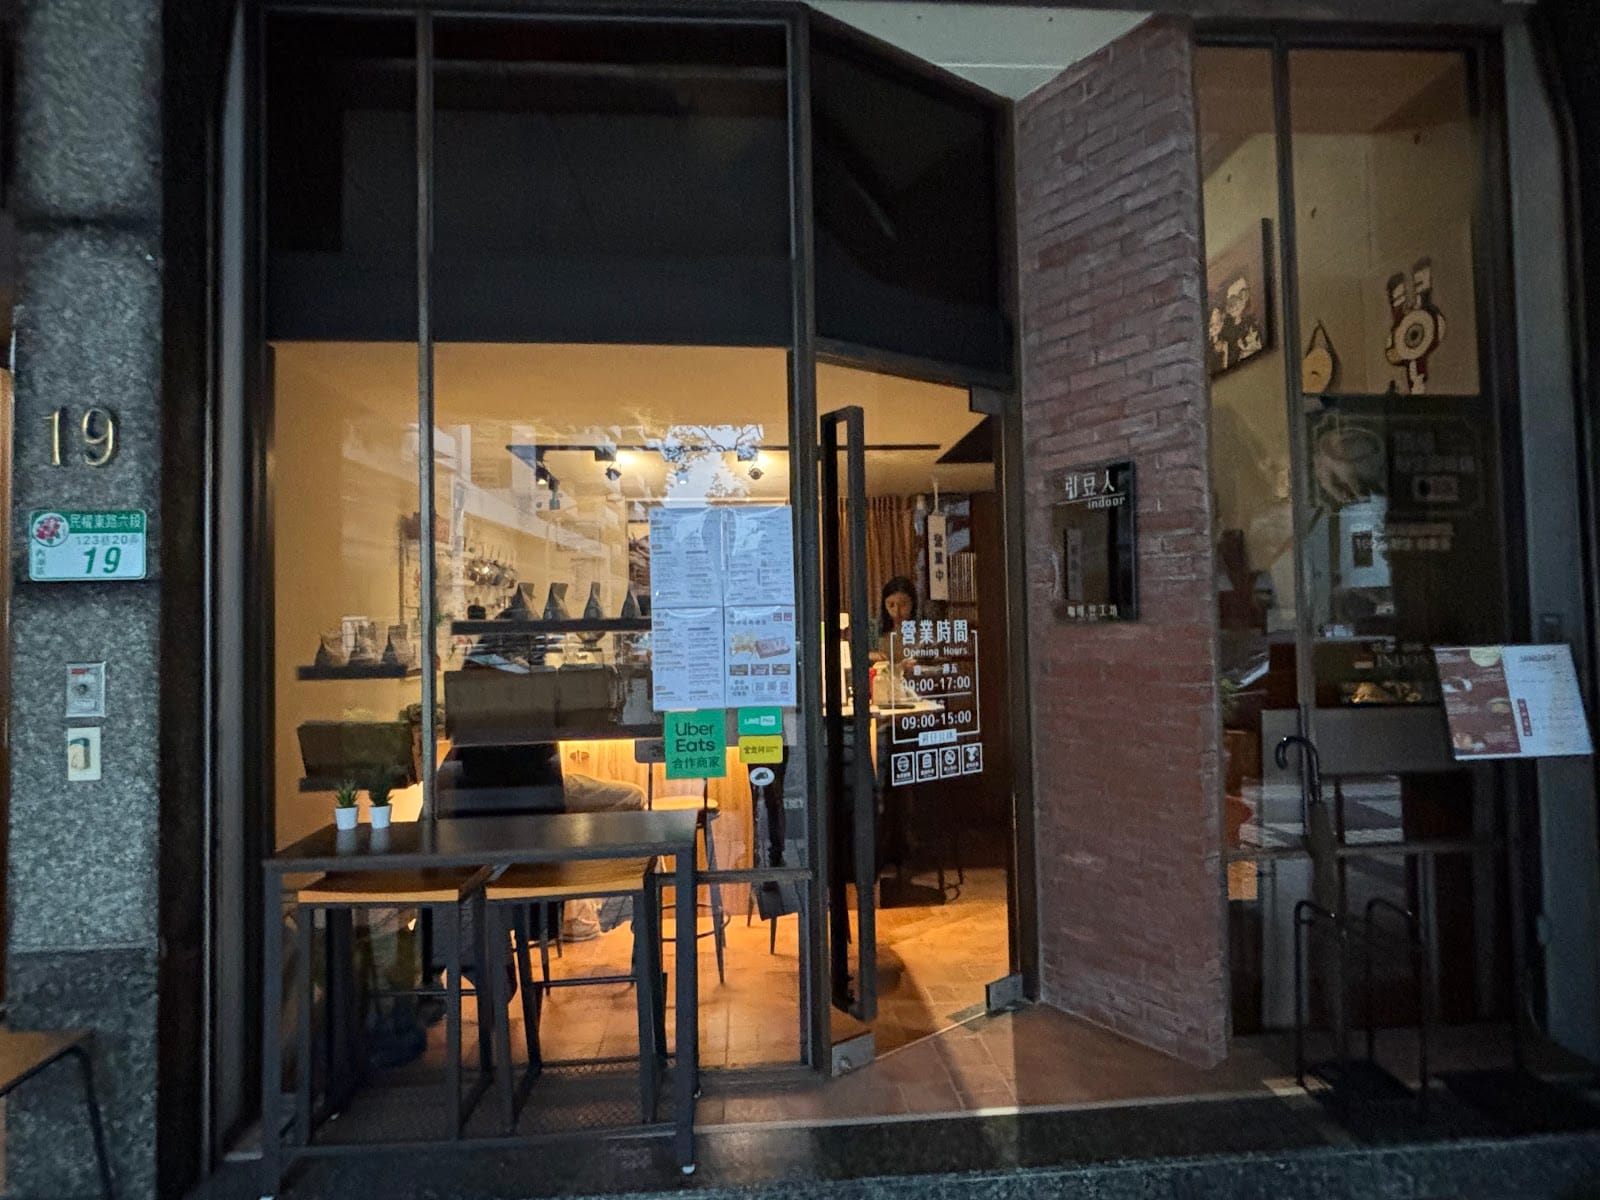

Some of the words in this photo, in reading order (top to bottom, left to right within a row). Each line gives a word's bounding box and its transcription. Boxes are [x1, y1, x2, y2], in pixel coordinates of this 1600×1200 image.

[42, 407, 114, 466] 19
[1087, 496, 1126, 510] indoor
[83, 546, 122, 575] 19
[901, 619, 969, 646] 營業時間
[903, 648, 940, 658] Opening
[943, 646, 968, 656] Hours
[901, 710, 972, 731] 09:00-15:00
[675, 722, 715, 737] Uber
[675, 738, 716, 753] Eats
[671, 756, 721, 770] 合作商家
